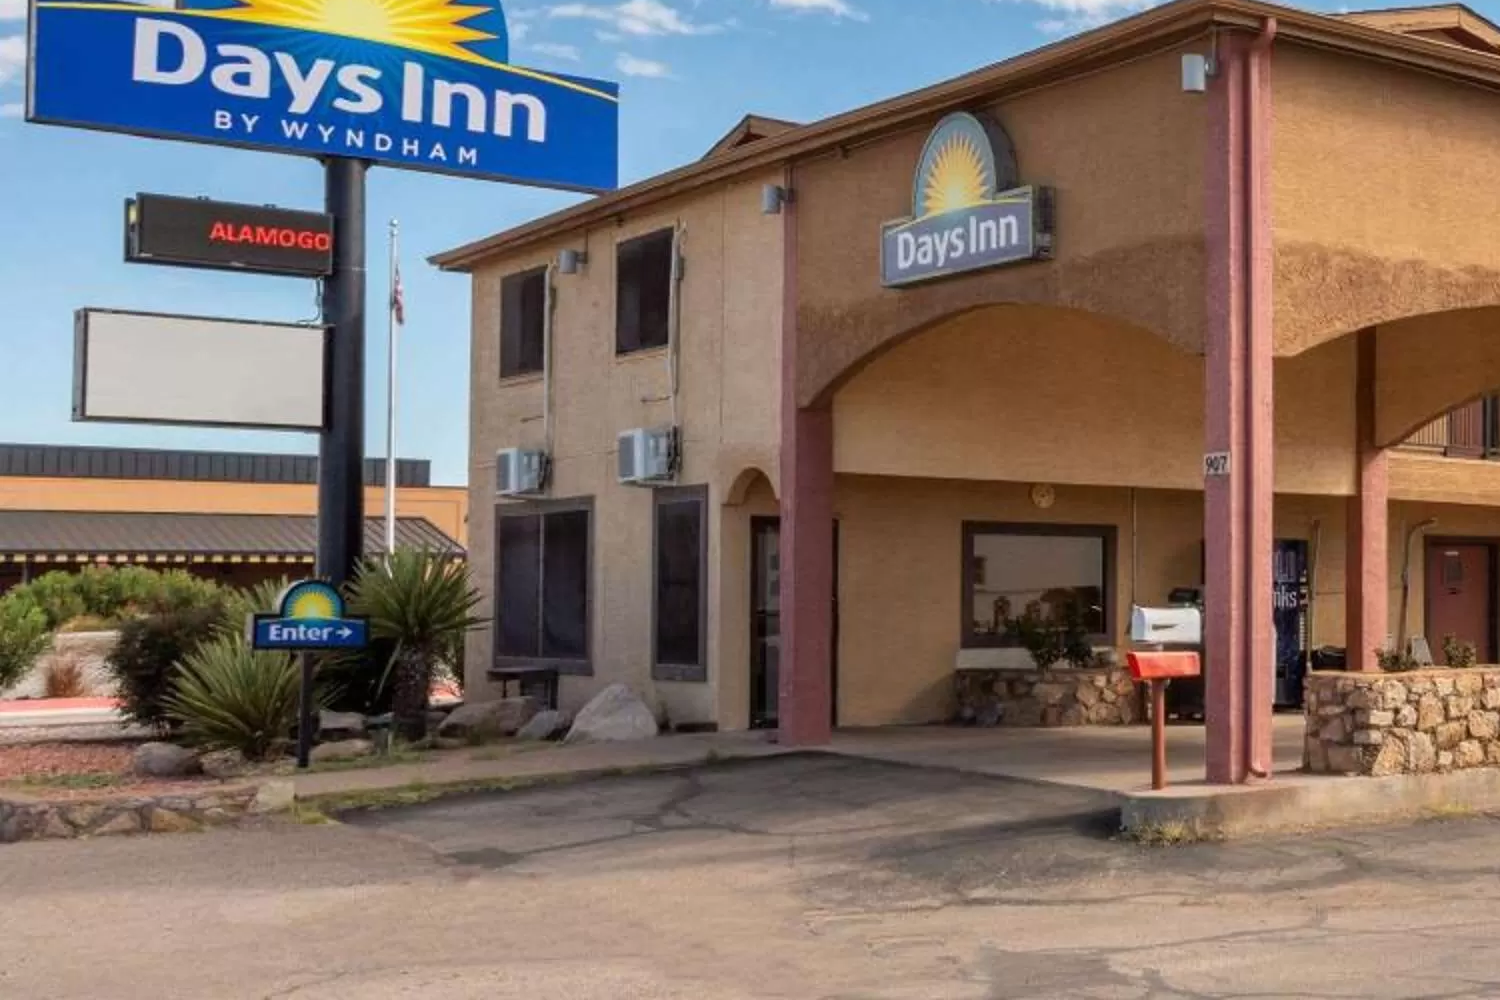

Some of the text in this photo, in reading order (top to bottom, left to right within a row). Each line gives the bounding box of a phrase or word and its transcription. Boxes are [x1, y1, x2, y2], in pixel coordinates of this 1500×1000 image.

[132, 17, 547, 143] Days Inn
[213, 110, 478, 166] BY WYNDHAM
[209, 220, 331, 251] ALAMOGO
[897, 214, 1019, 270] Days Inn
[1205, 455, 1228, 473] 907
[269, 624, 334, 641] Enter
